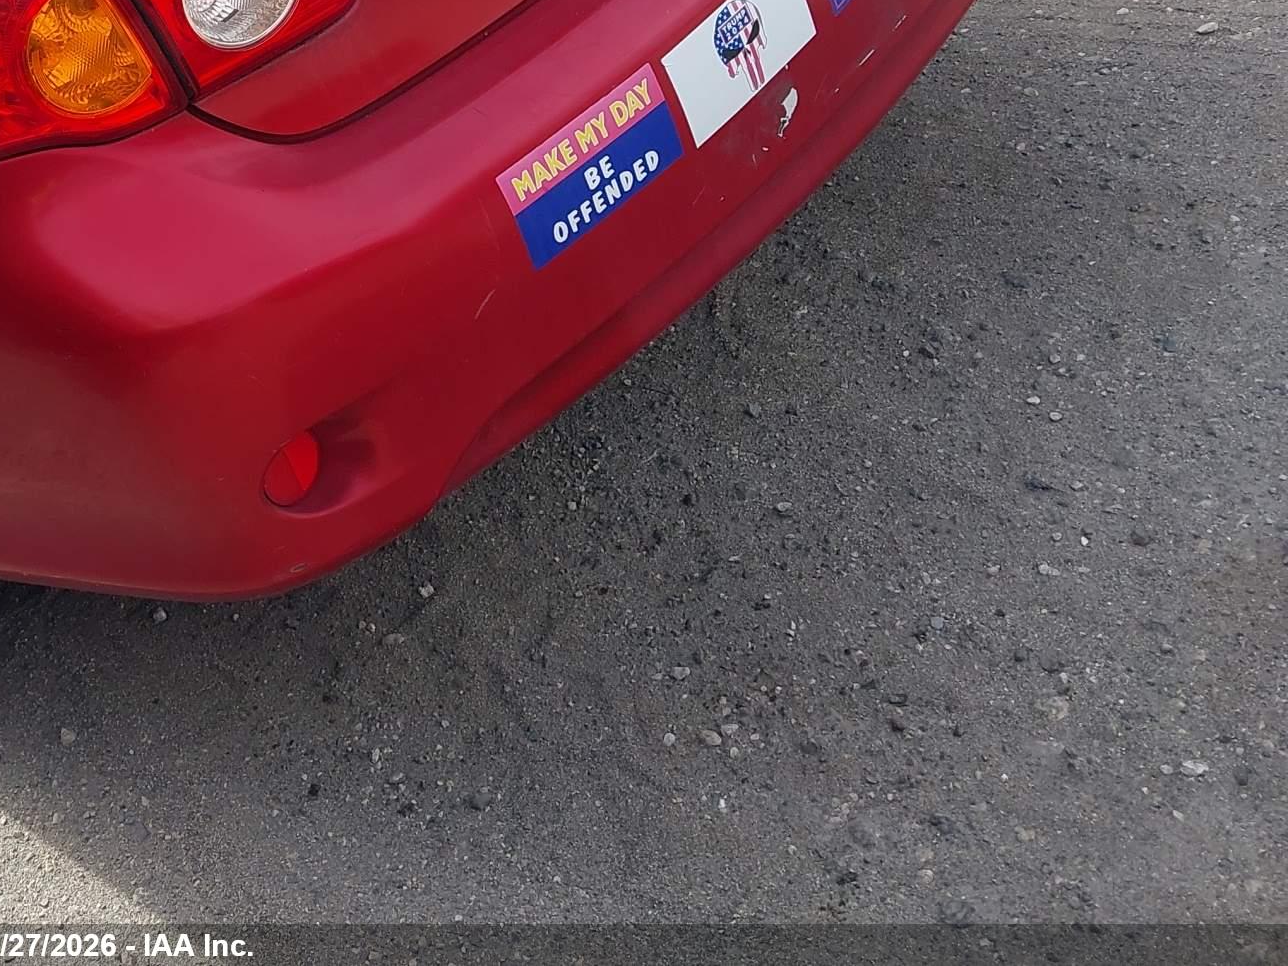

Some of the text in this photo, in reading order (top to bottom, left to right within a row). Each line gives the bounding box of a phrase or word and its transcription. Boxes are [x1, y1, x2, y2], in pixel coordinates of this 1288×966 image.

[722, 9, 746, 34] TRUMP
[726, 15, 749, 41] 2024
[510, 77, 653, 203] MAKE MY DAY
[583, 154, 616, 192] BE
[552, 149, 660, 244] OFFENDED
